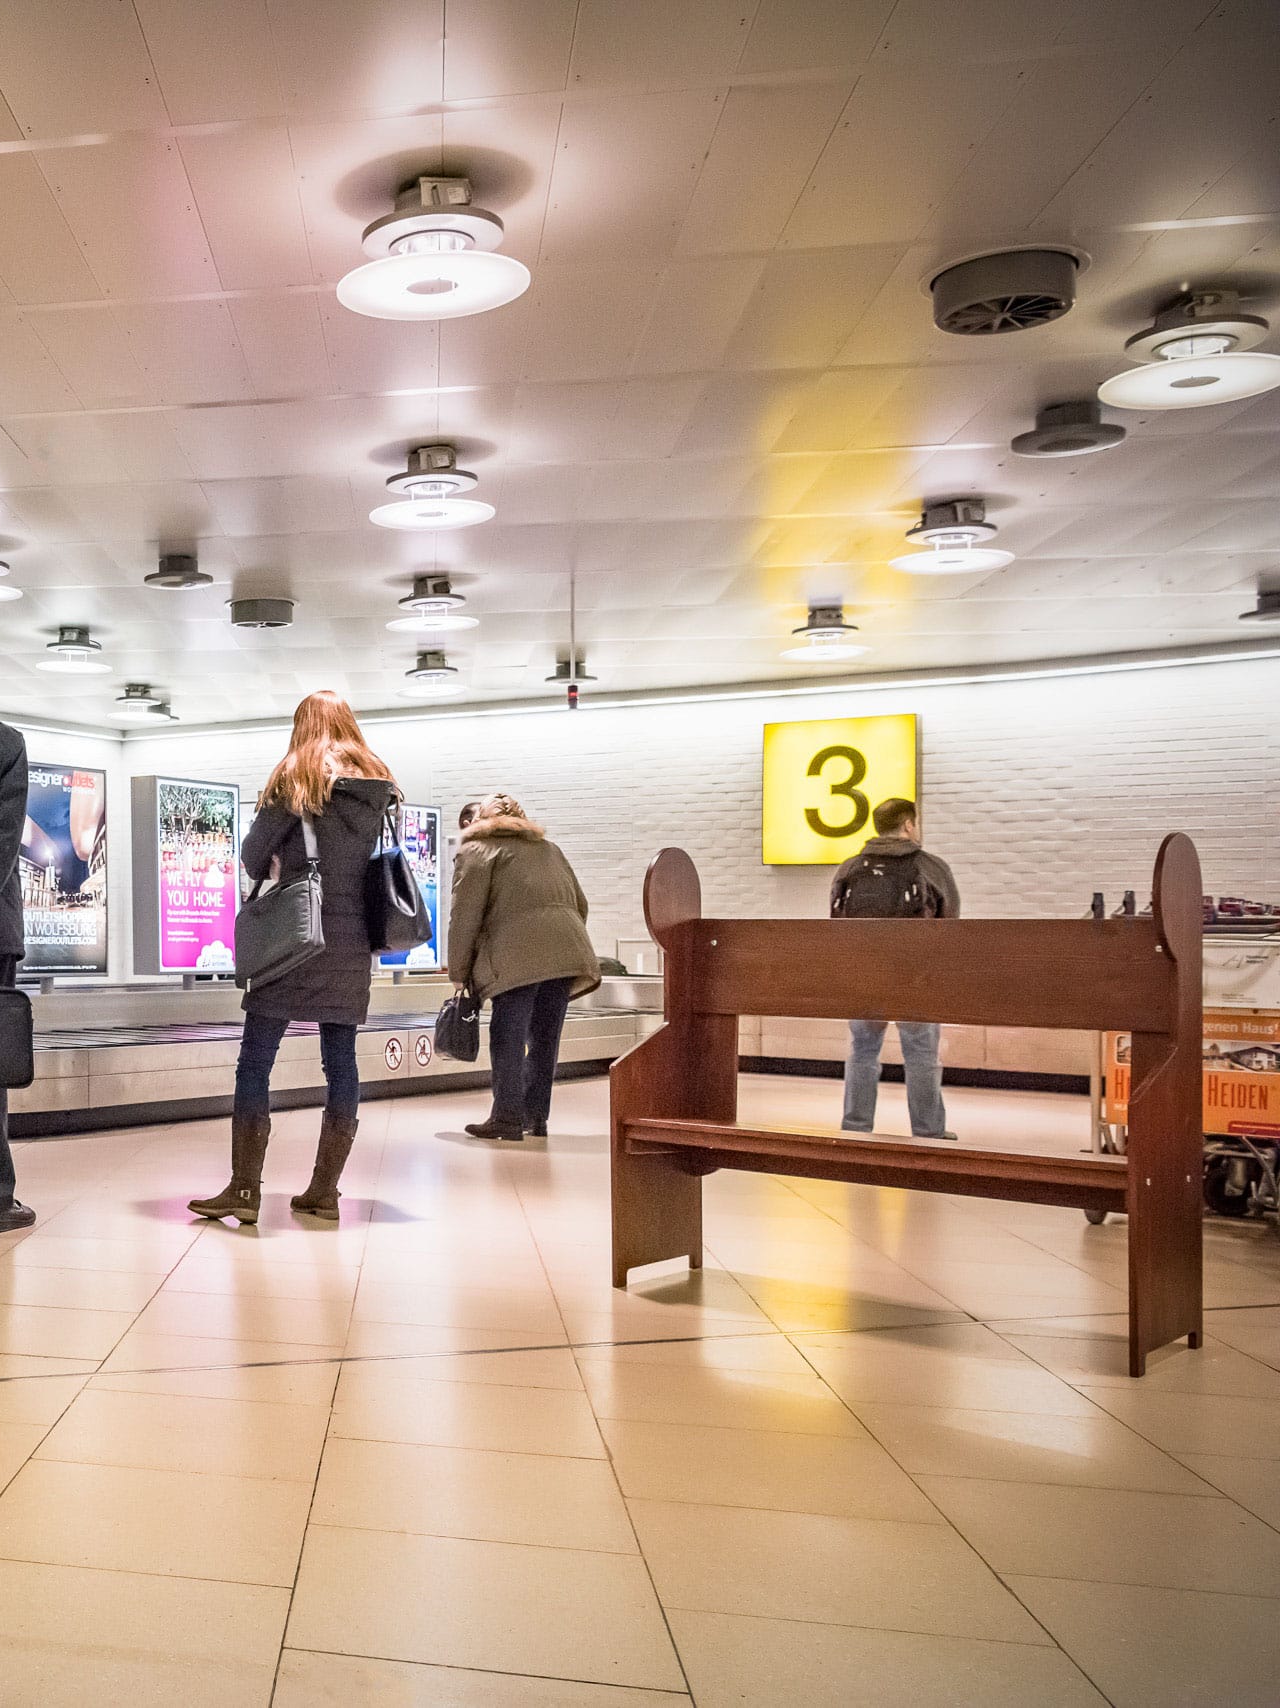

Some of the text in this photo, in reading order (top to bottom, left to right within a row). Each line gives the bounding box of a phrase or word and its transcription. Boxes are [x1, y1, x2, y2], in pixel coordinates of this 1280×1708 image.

[28, 768, 95, 788] esigneroutlets
[804, 745, 869, 838] 3
[167, 890, 189, 907] YOU
[1242, 1022, 1279, 1035] Haus!
[1207, 1074, 1269, 1110] HEIDEN
